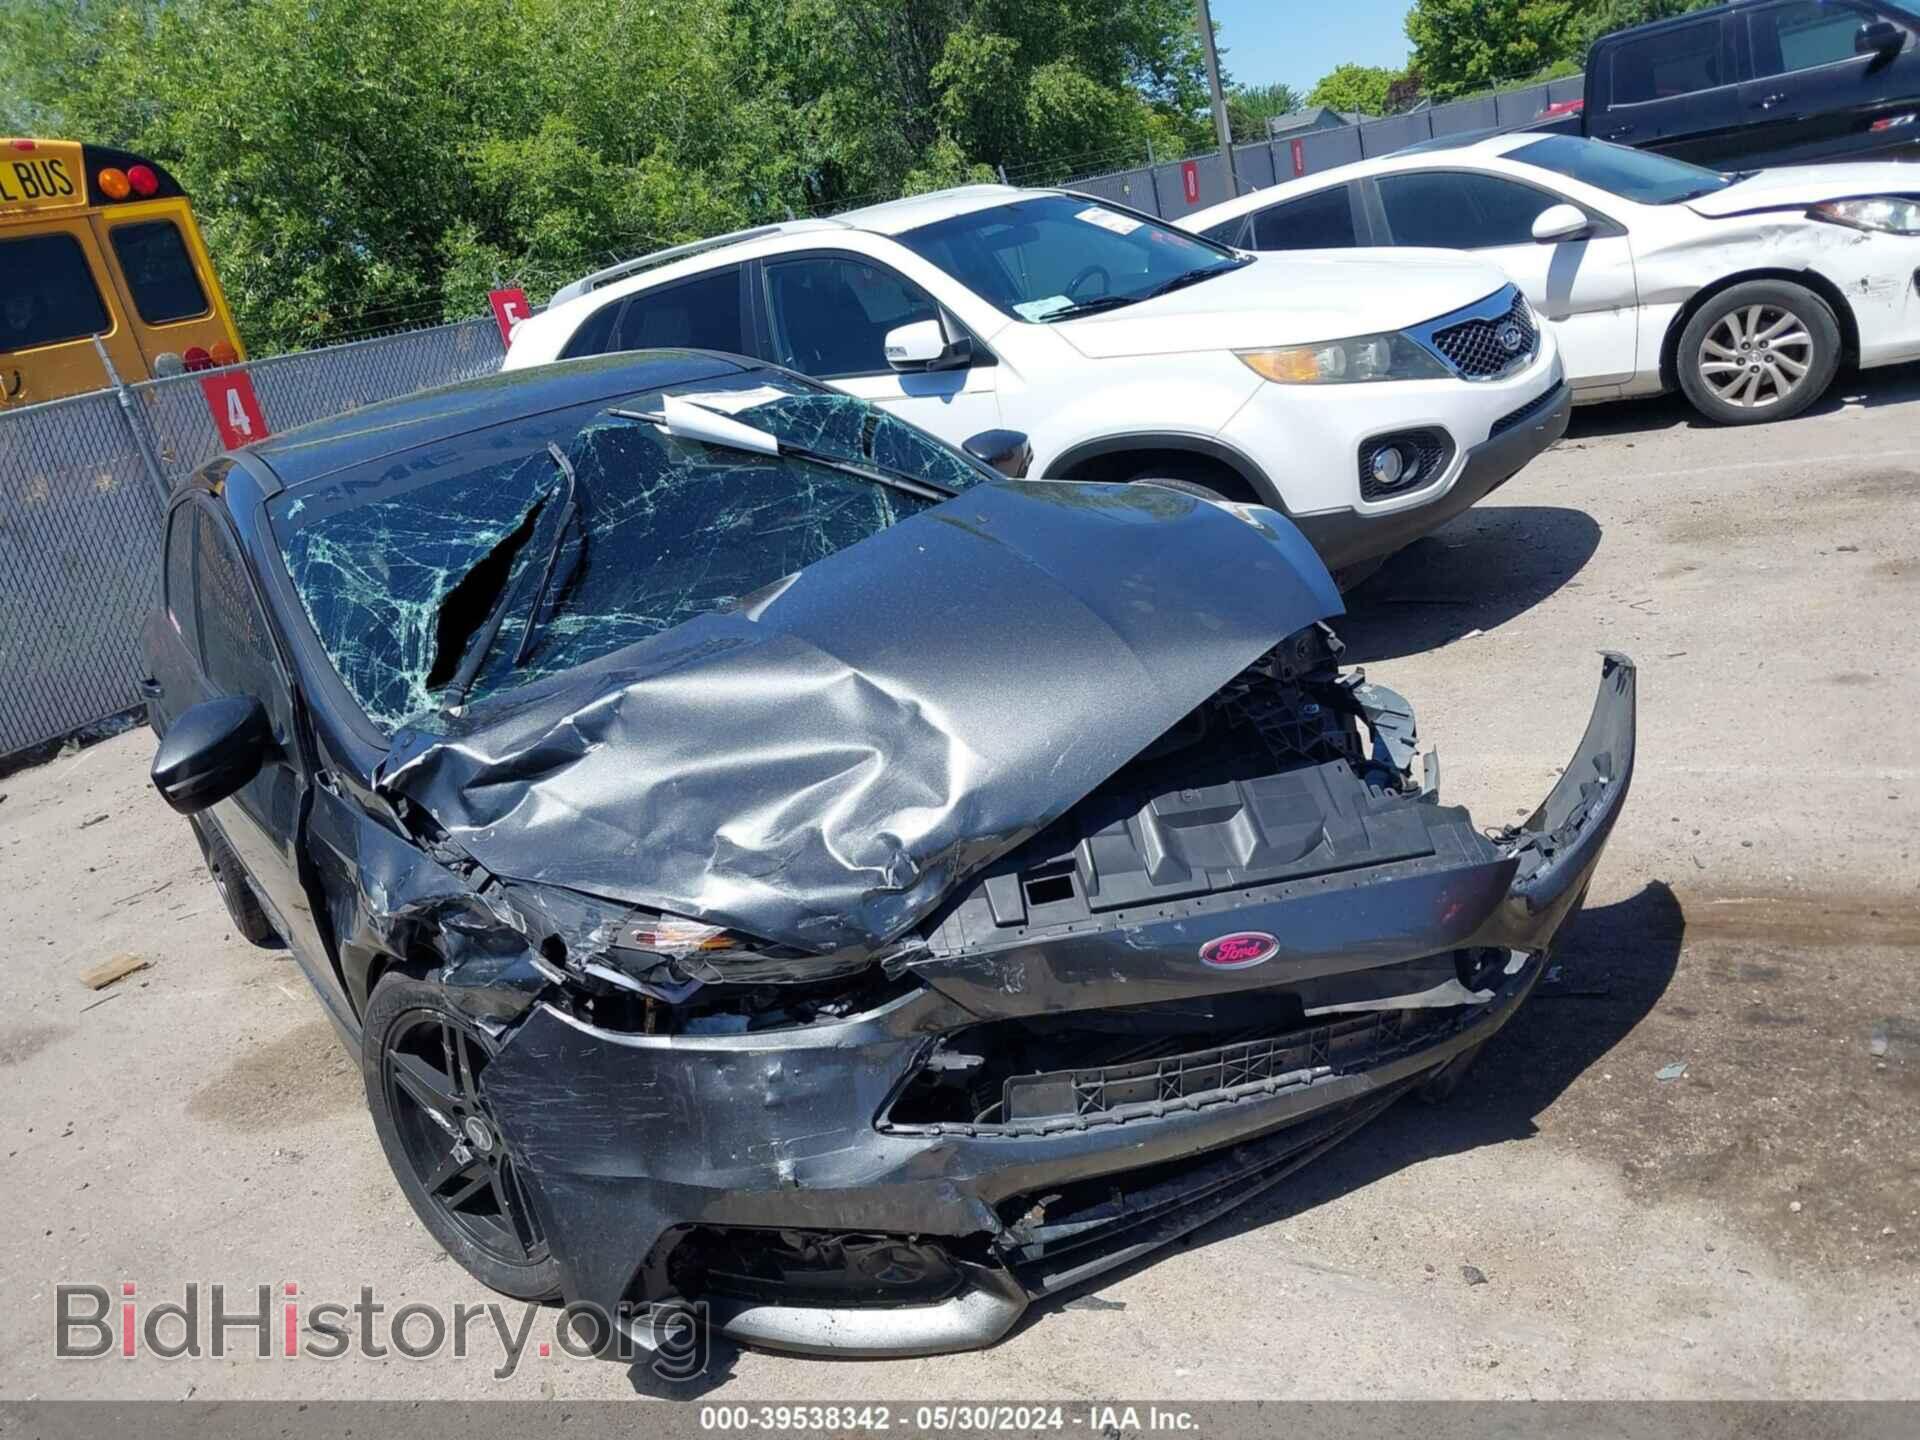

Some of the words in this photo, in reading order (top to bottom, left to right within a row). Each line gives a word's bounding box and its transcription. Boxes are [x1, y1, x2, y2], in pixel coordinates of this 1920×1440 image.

[12, 159, 74, 199] BUS
[226, 388, 252, 436] 4
[1216, 939, 1261, 962] Ford
